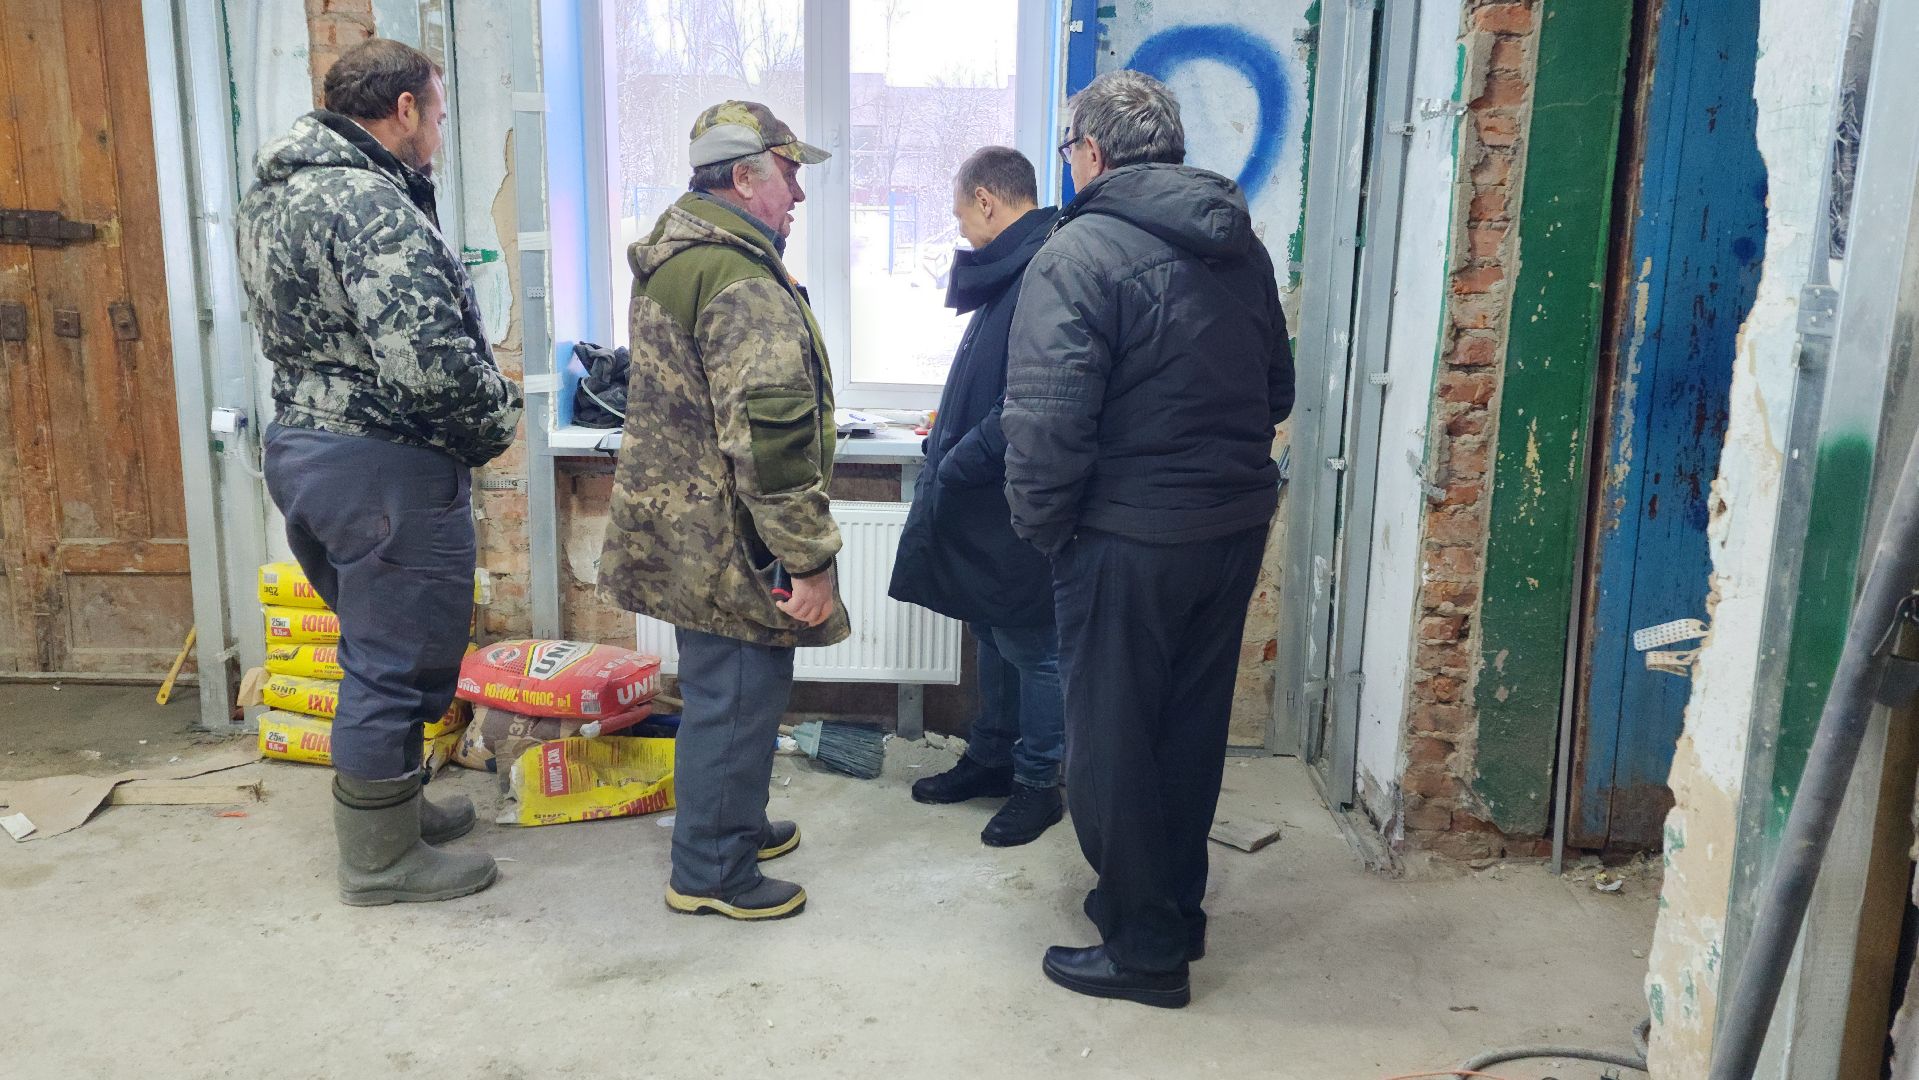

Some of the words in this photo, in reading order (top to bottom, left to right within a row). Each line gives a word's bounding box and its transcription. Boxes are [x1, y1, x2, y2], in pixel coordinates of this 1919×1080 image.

[302, 614, 340, 633] ЮНИ
[534, 642, 577, 674] UNI
[271, 683, 297, 696] UNIS
[457, 681, 481, 694] UNIS
[484, 682, 519, 703] ЮНИС
[522, 691, 554, 707] ПЛЮС
[581, 688, 599, 700] 25кг
